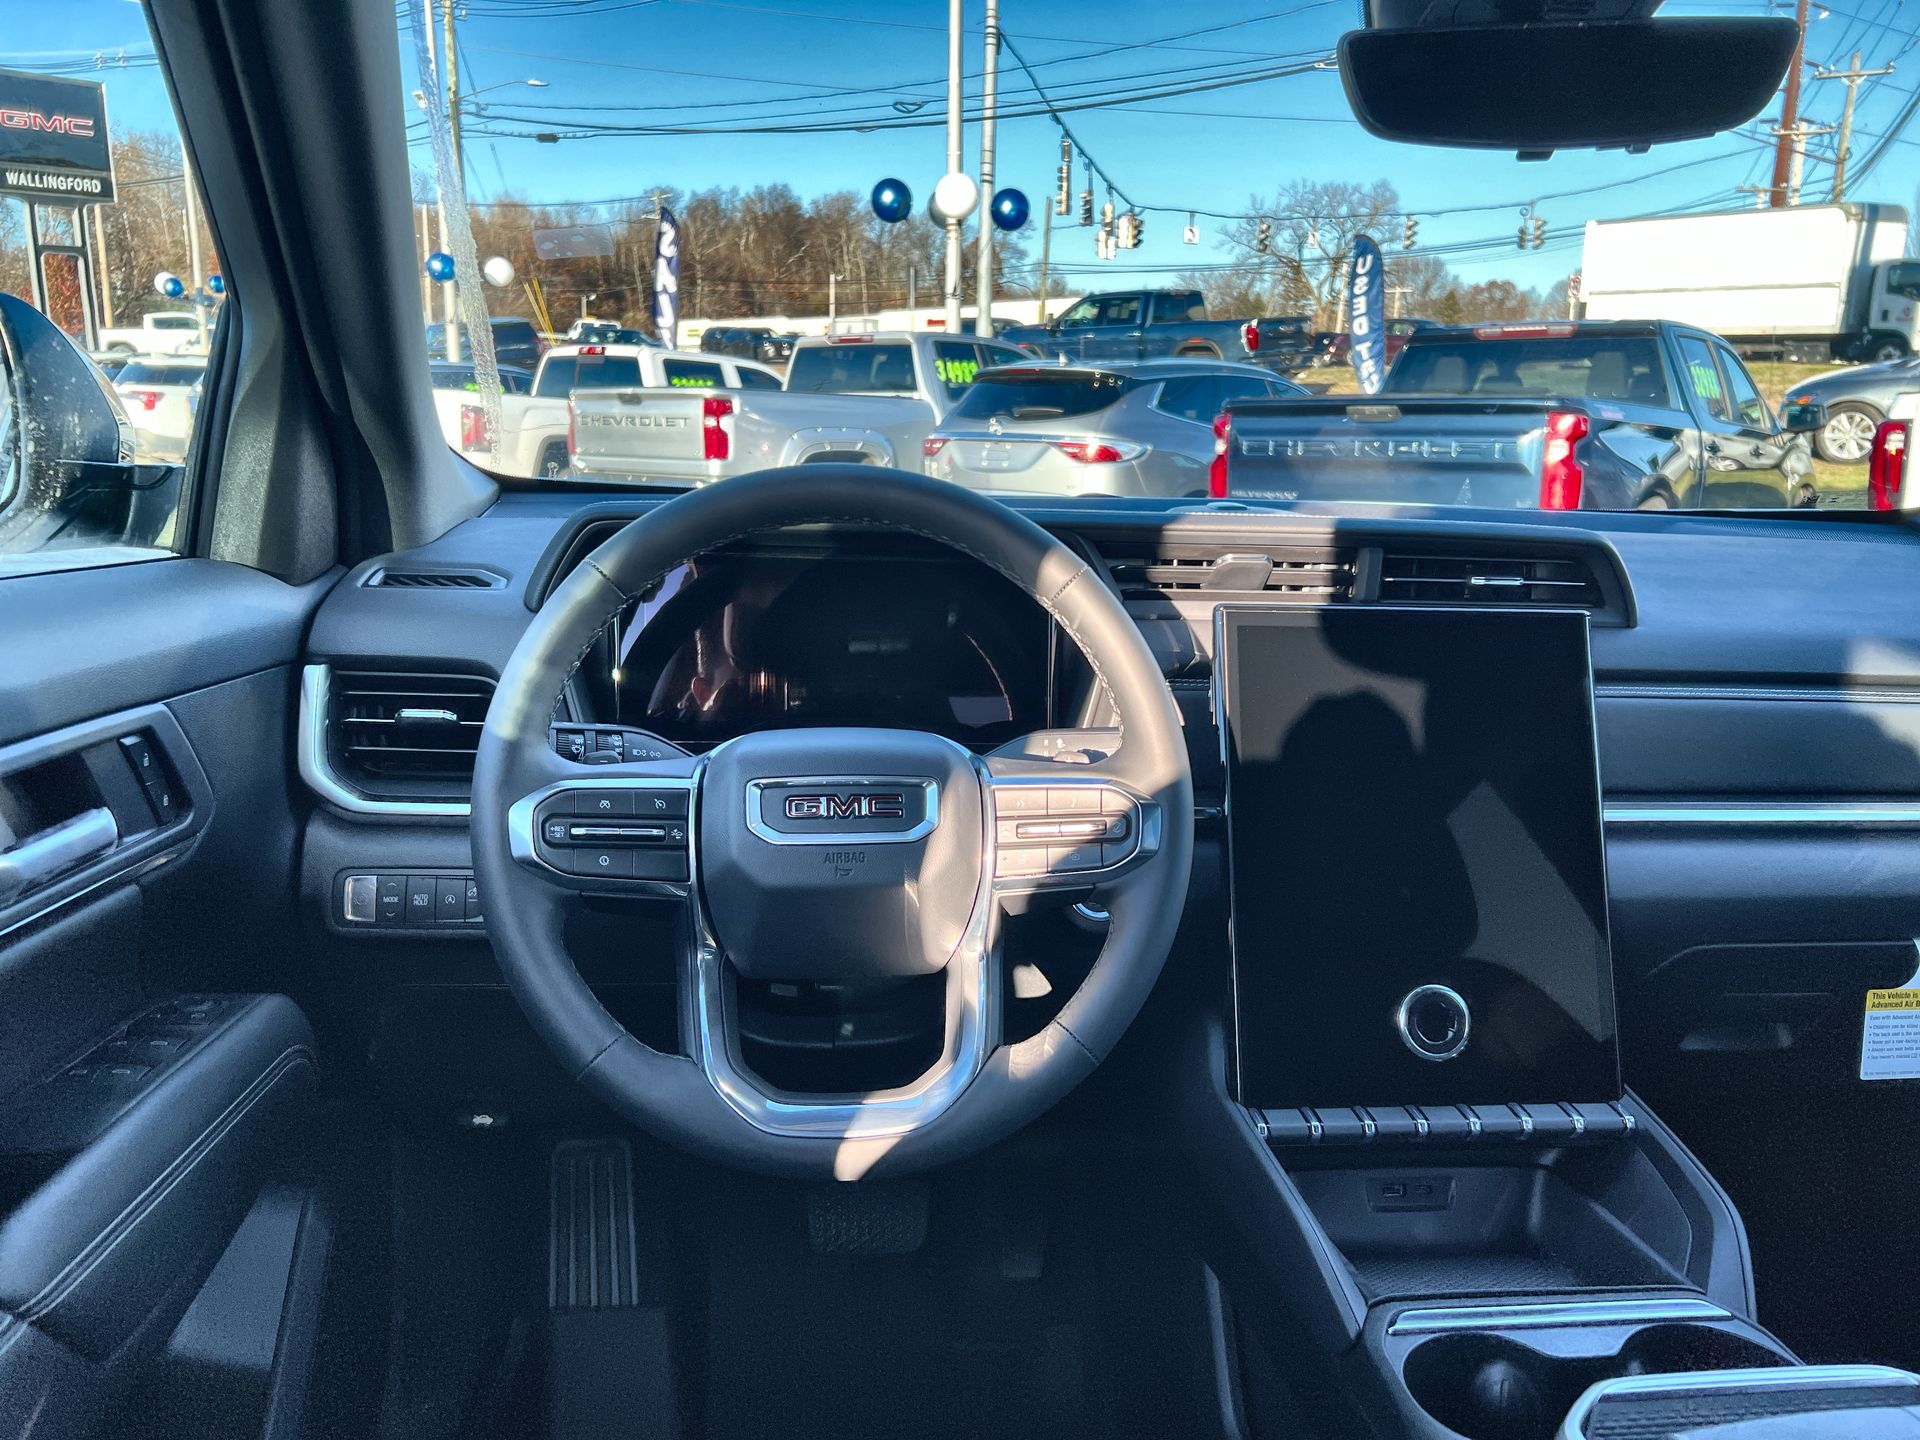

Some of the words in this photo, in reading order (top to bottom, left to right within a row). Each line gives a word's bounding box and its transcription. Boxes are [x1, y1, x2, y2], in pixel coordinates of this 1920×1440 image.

[0, 109, 94, 137] GMC
[5, 171, 102, 193] WALLINGFORD
[580, 415, 691, 428] CHEVROLET
[1241, 439, 1518, 459] CHEVROLET
[786, 796, 904, 818] GMC
[824, 851, 866, 864] AIRBAG
[1872, 1000, 1903, 1008] Advanced
